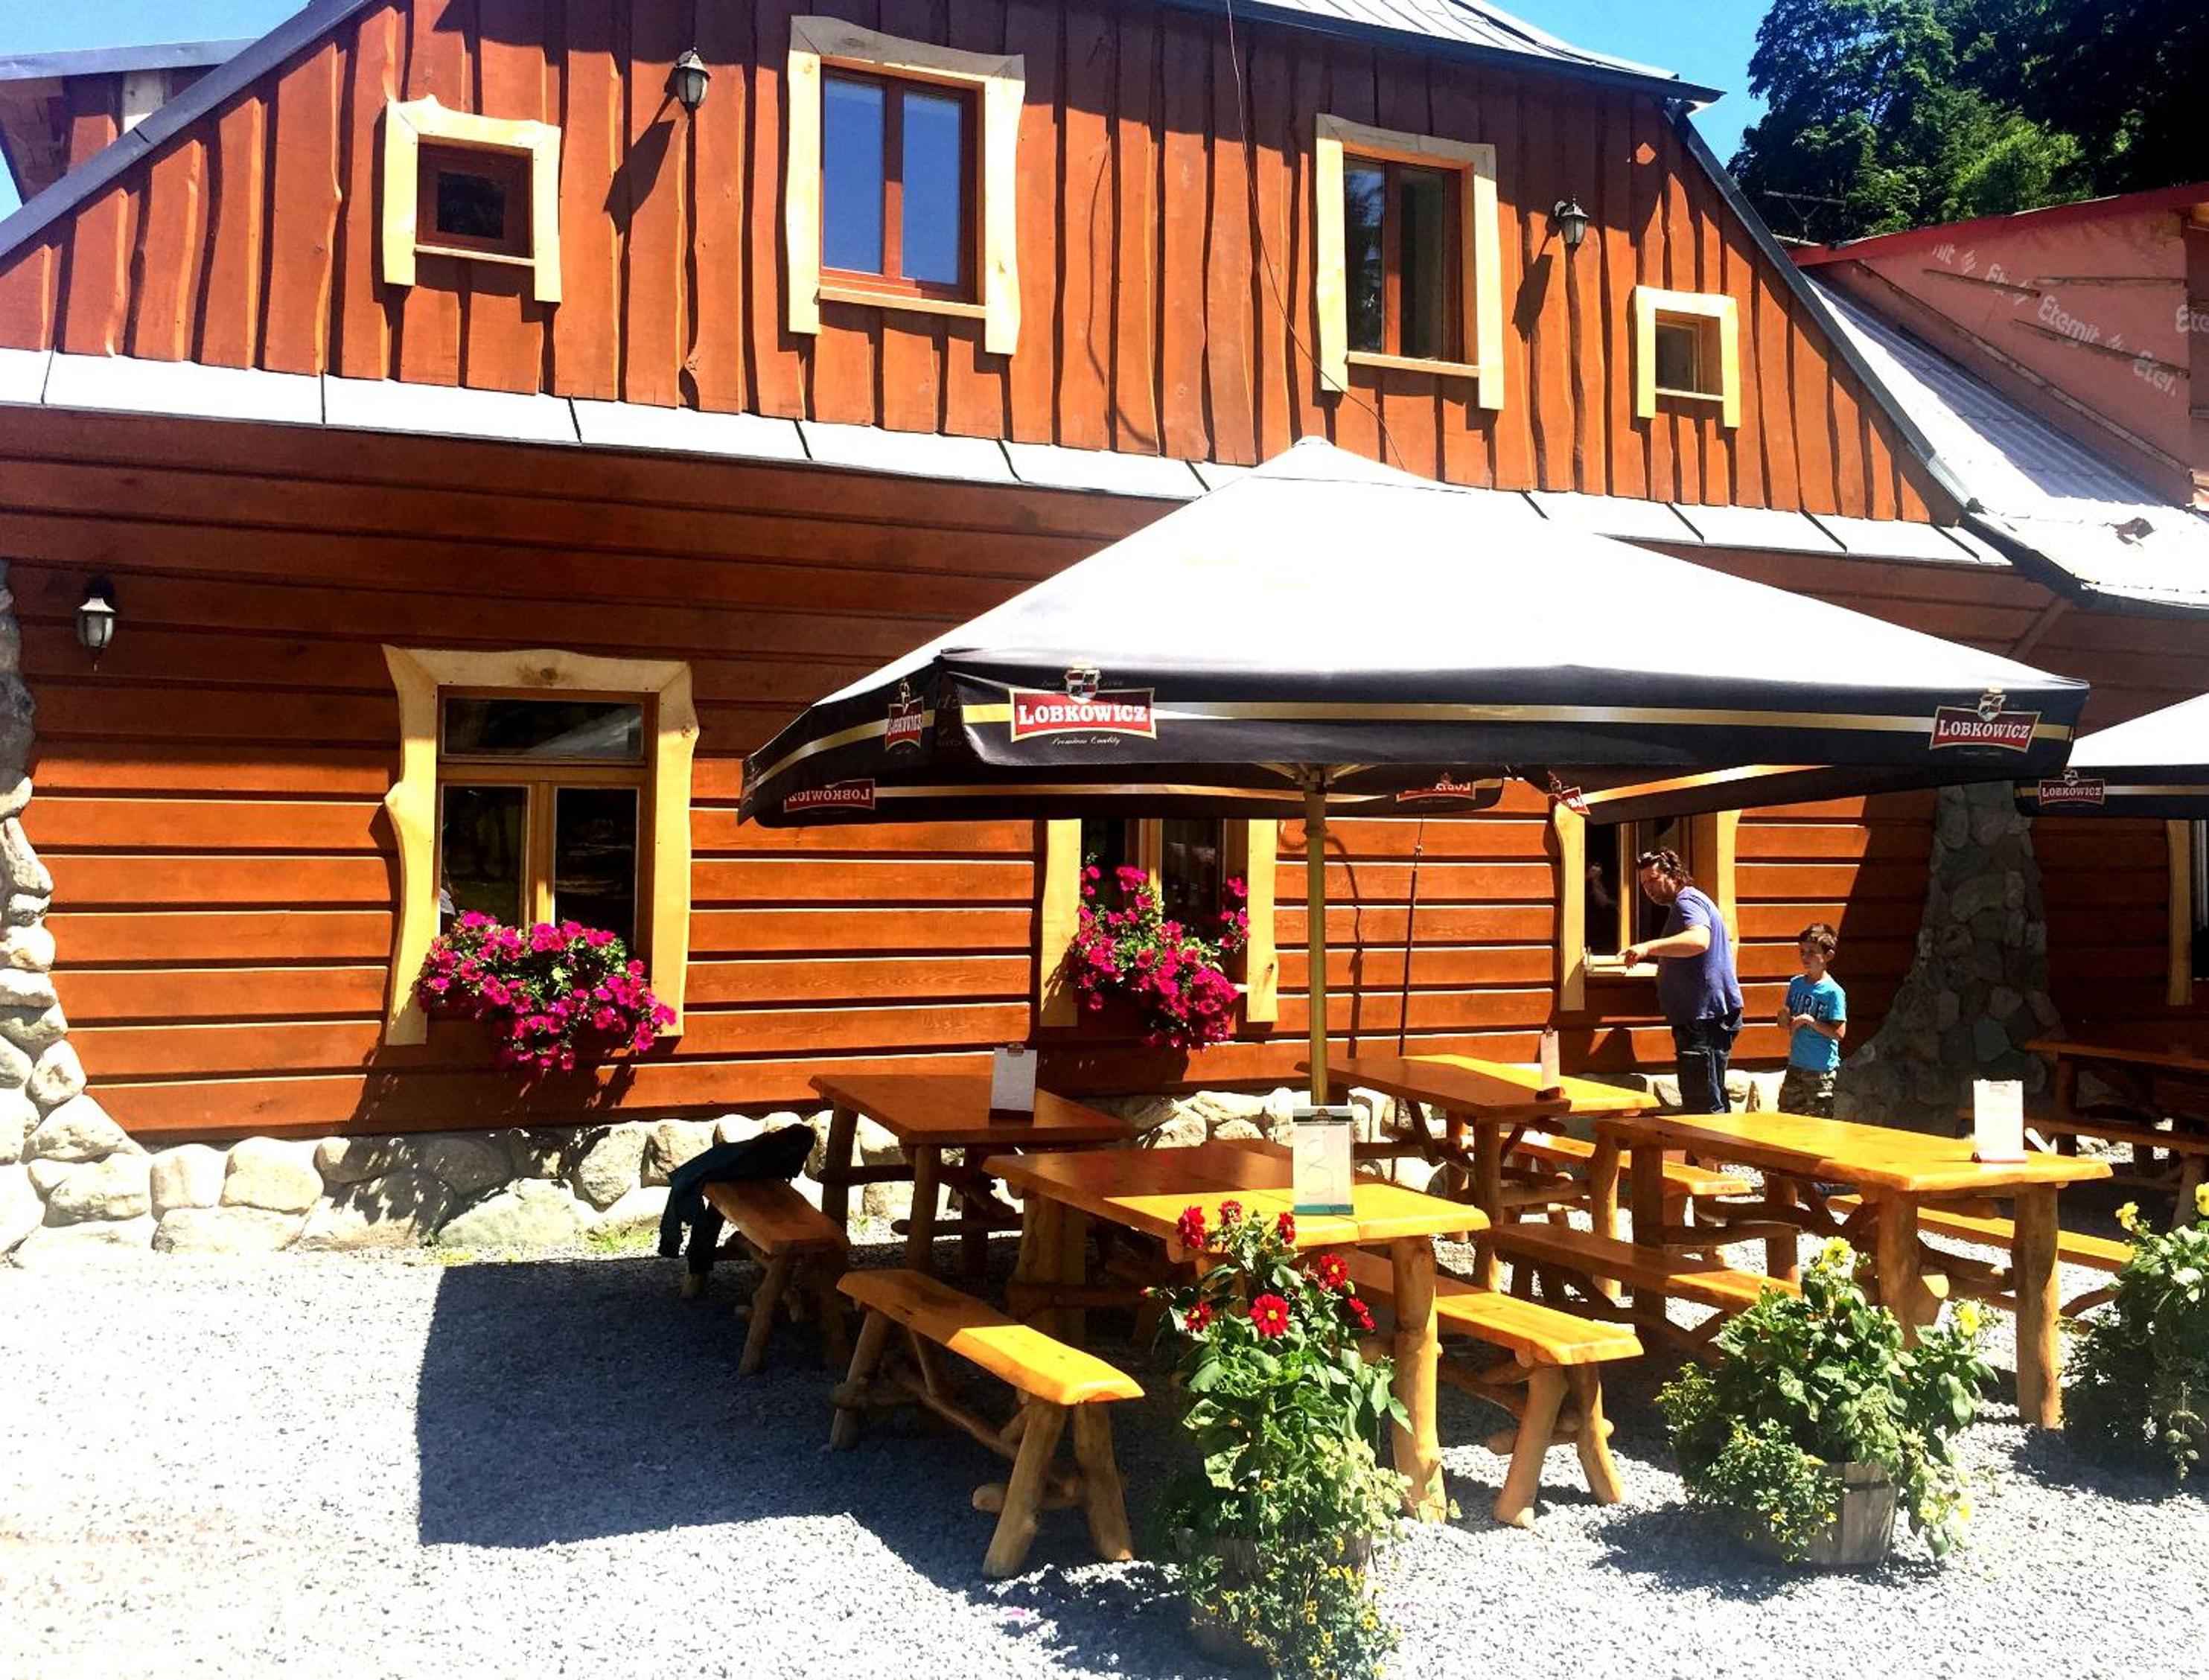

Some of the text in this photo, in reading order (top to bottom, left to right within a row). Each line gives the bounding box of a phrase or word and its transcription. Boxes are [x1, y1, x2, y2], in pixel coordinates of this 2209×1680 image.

[1019, 704, 1149, 725] LOBKOWICZ
[1938, 720, 2031, 739] LOBKOWICZ
[2041, 787, 2102, 797] LOBKOWICZ
